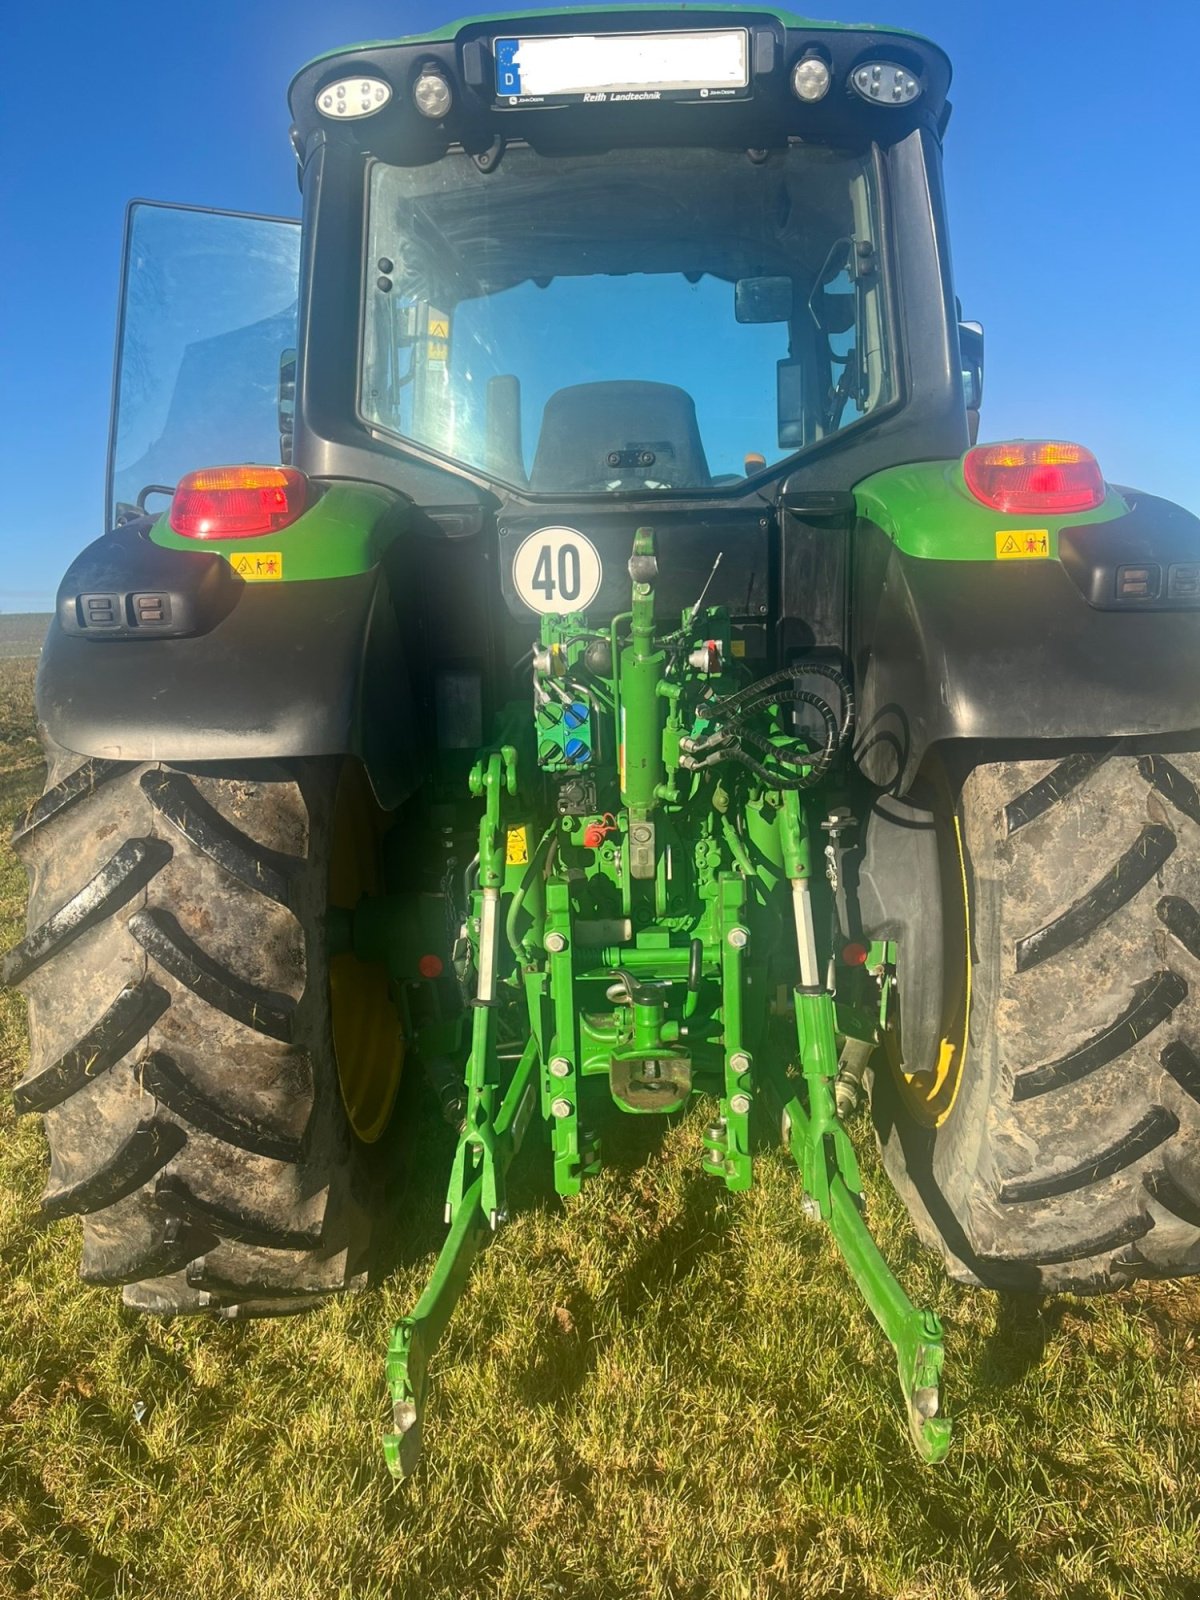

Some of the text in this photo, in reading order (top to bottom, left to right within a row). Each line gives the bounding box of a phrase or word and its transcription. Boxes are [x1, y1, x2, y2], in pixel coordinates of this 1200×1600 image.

[505, 72, 514, 86] D
[583, 91, 661, 102] Reith Landtechnik
[532, 543, 581, 601] 40
